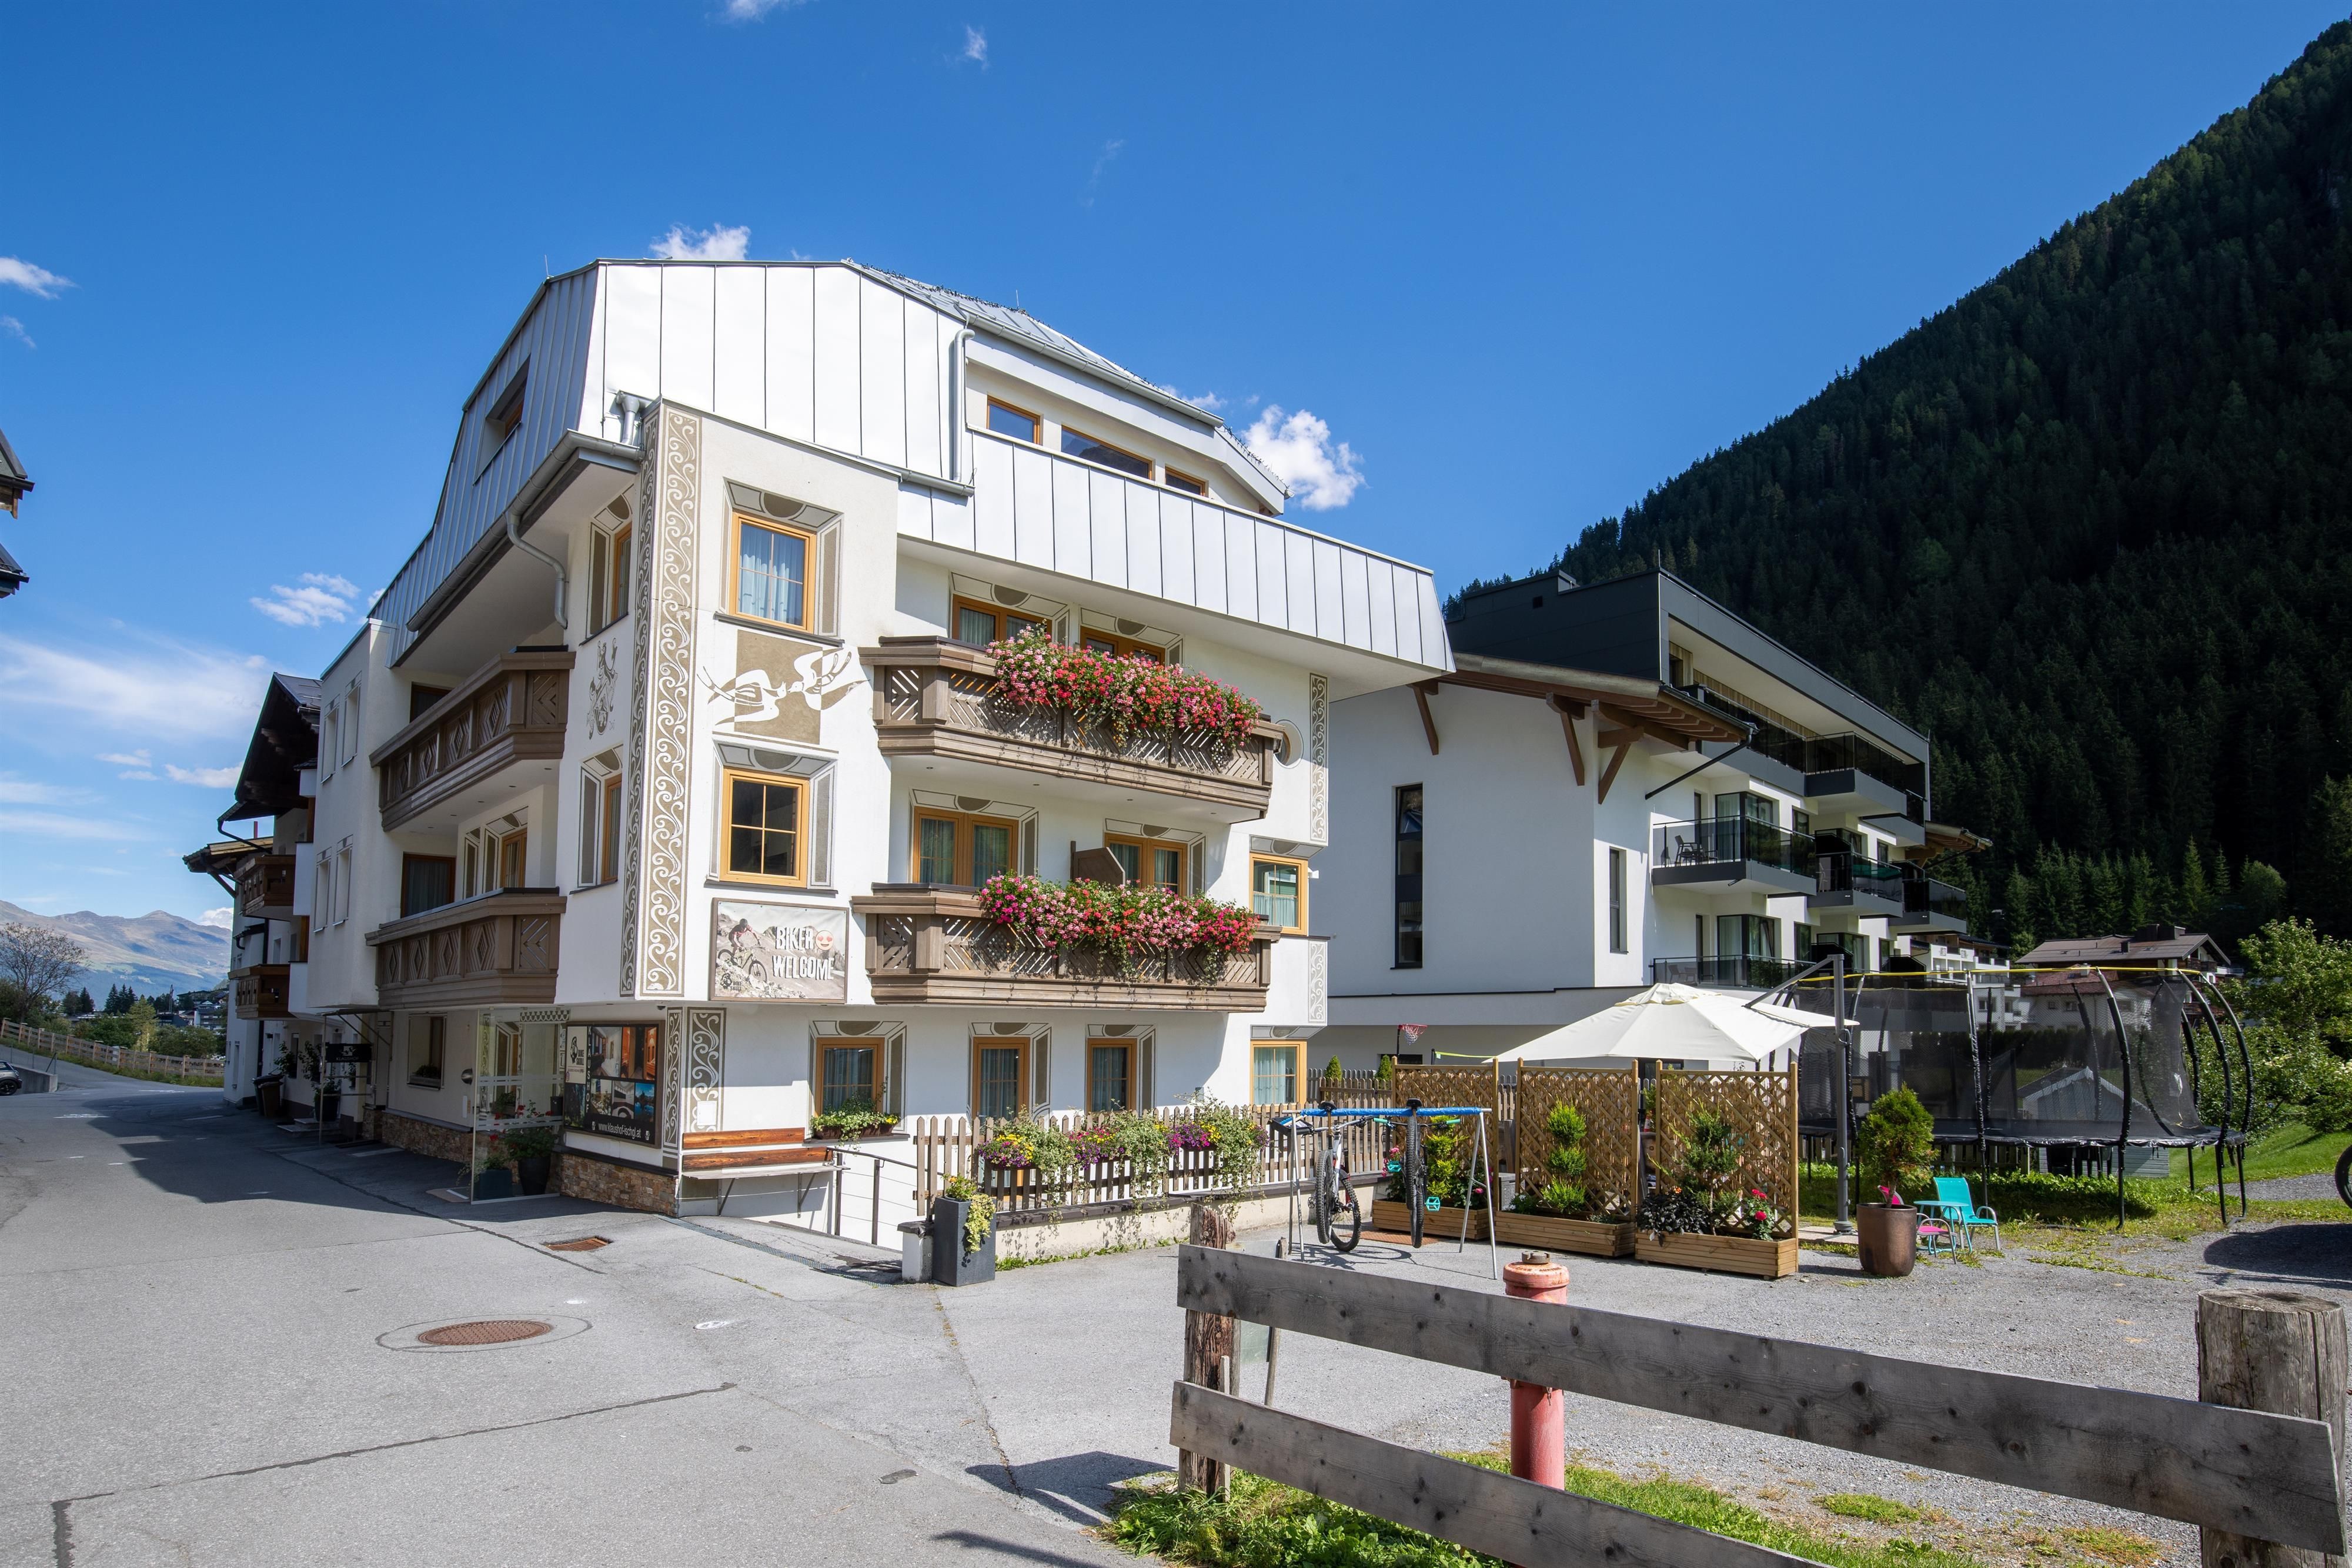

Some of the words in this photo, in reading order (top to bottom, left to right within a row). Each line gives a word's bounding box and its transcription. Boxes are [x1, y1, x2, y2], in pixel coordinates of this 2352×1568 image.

[776, 927, 813, 950] BIKER
[772, 955, 834, 980] WELCOME
[598, 1122, 641, 1139] www.klaushof-ischgl.at
